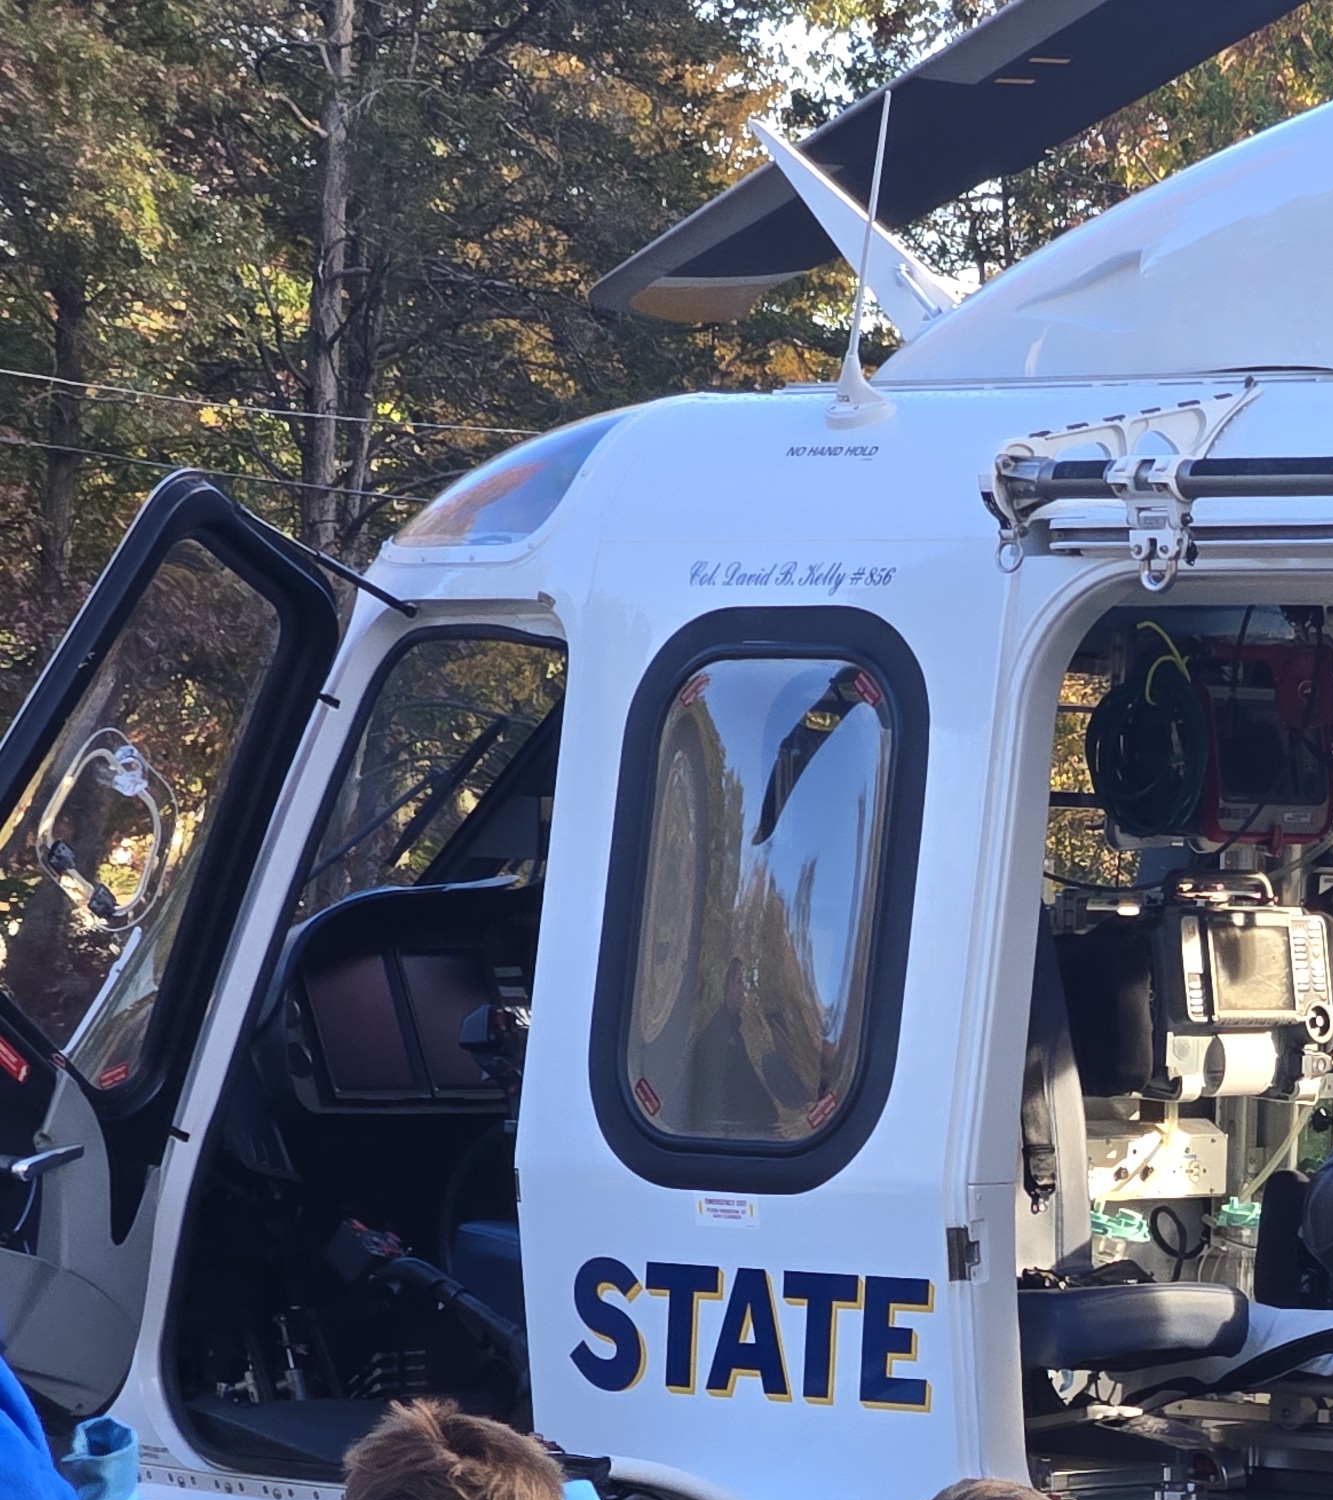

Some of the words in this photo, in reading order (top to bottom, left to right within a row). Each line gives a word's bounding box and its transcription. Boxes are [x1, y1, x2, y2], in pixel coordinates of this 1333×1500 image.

[786, 446, 807, 457] NO
[807, 446, 844, 457] HAND
[844, 445, 879, 456] HOLD
[721, 561, 778, 586] David
[798, 561, 847, 597] Kelly
[849, 566, 897, 586] #856
[569, 1256, 935, 1413] STATE
